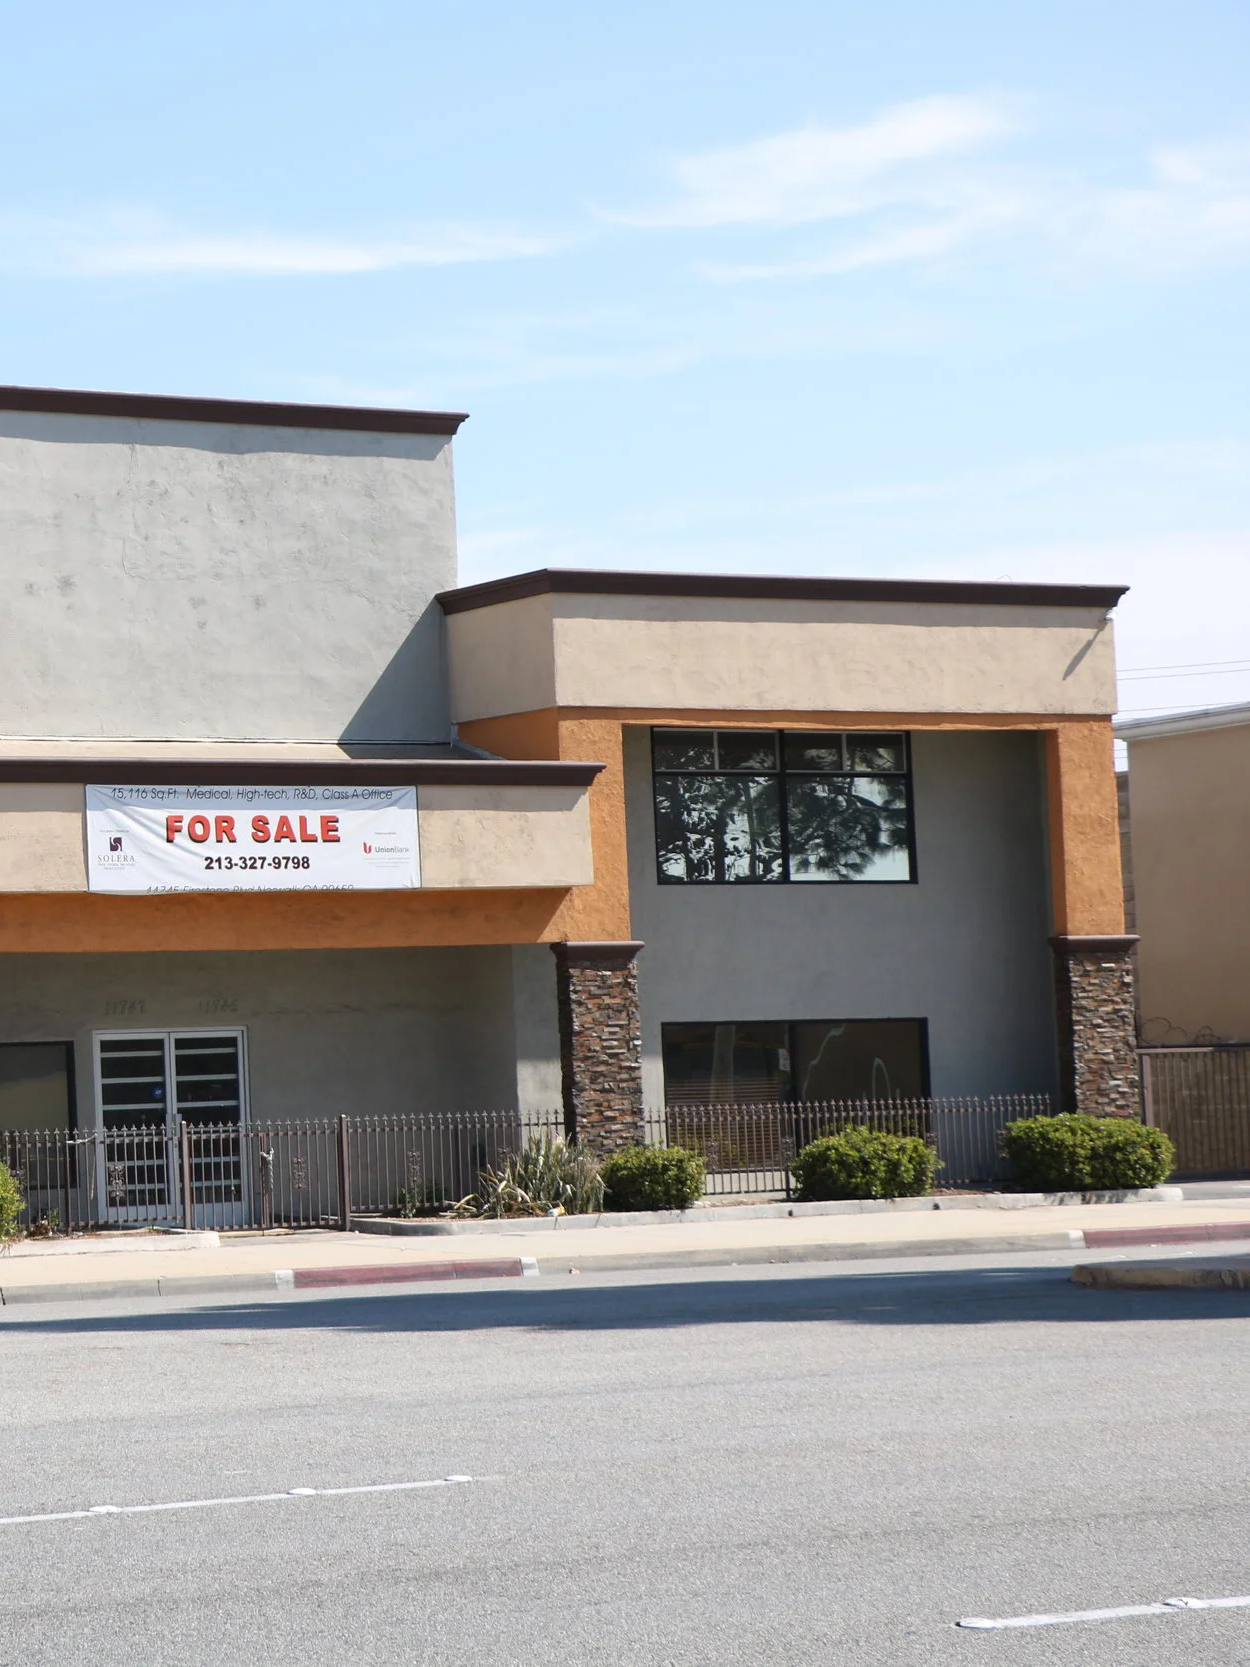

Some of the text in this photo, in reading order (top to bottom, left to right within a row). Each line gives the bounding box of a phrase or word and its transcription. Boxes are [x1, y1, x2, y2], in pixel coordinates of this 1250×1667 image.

[111, 788, 392, 802] 15,116 Sq.Ft. Medical, High-tech, R&D, Class A Office
[166, 815, 341, 843] FOR SALE
[97, 854, 135, 862] SOLERA
[204, 856, 310, 870] 213-327-9798
